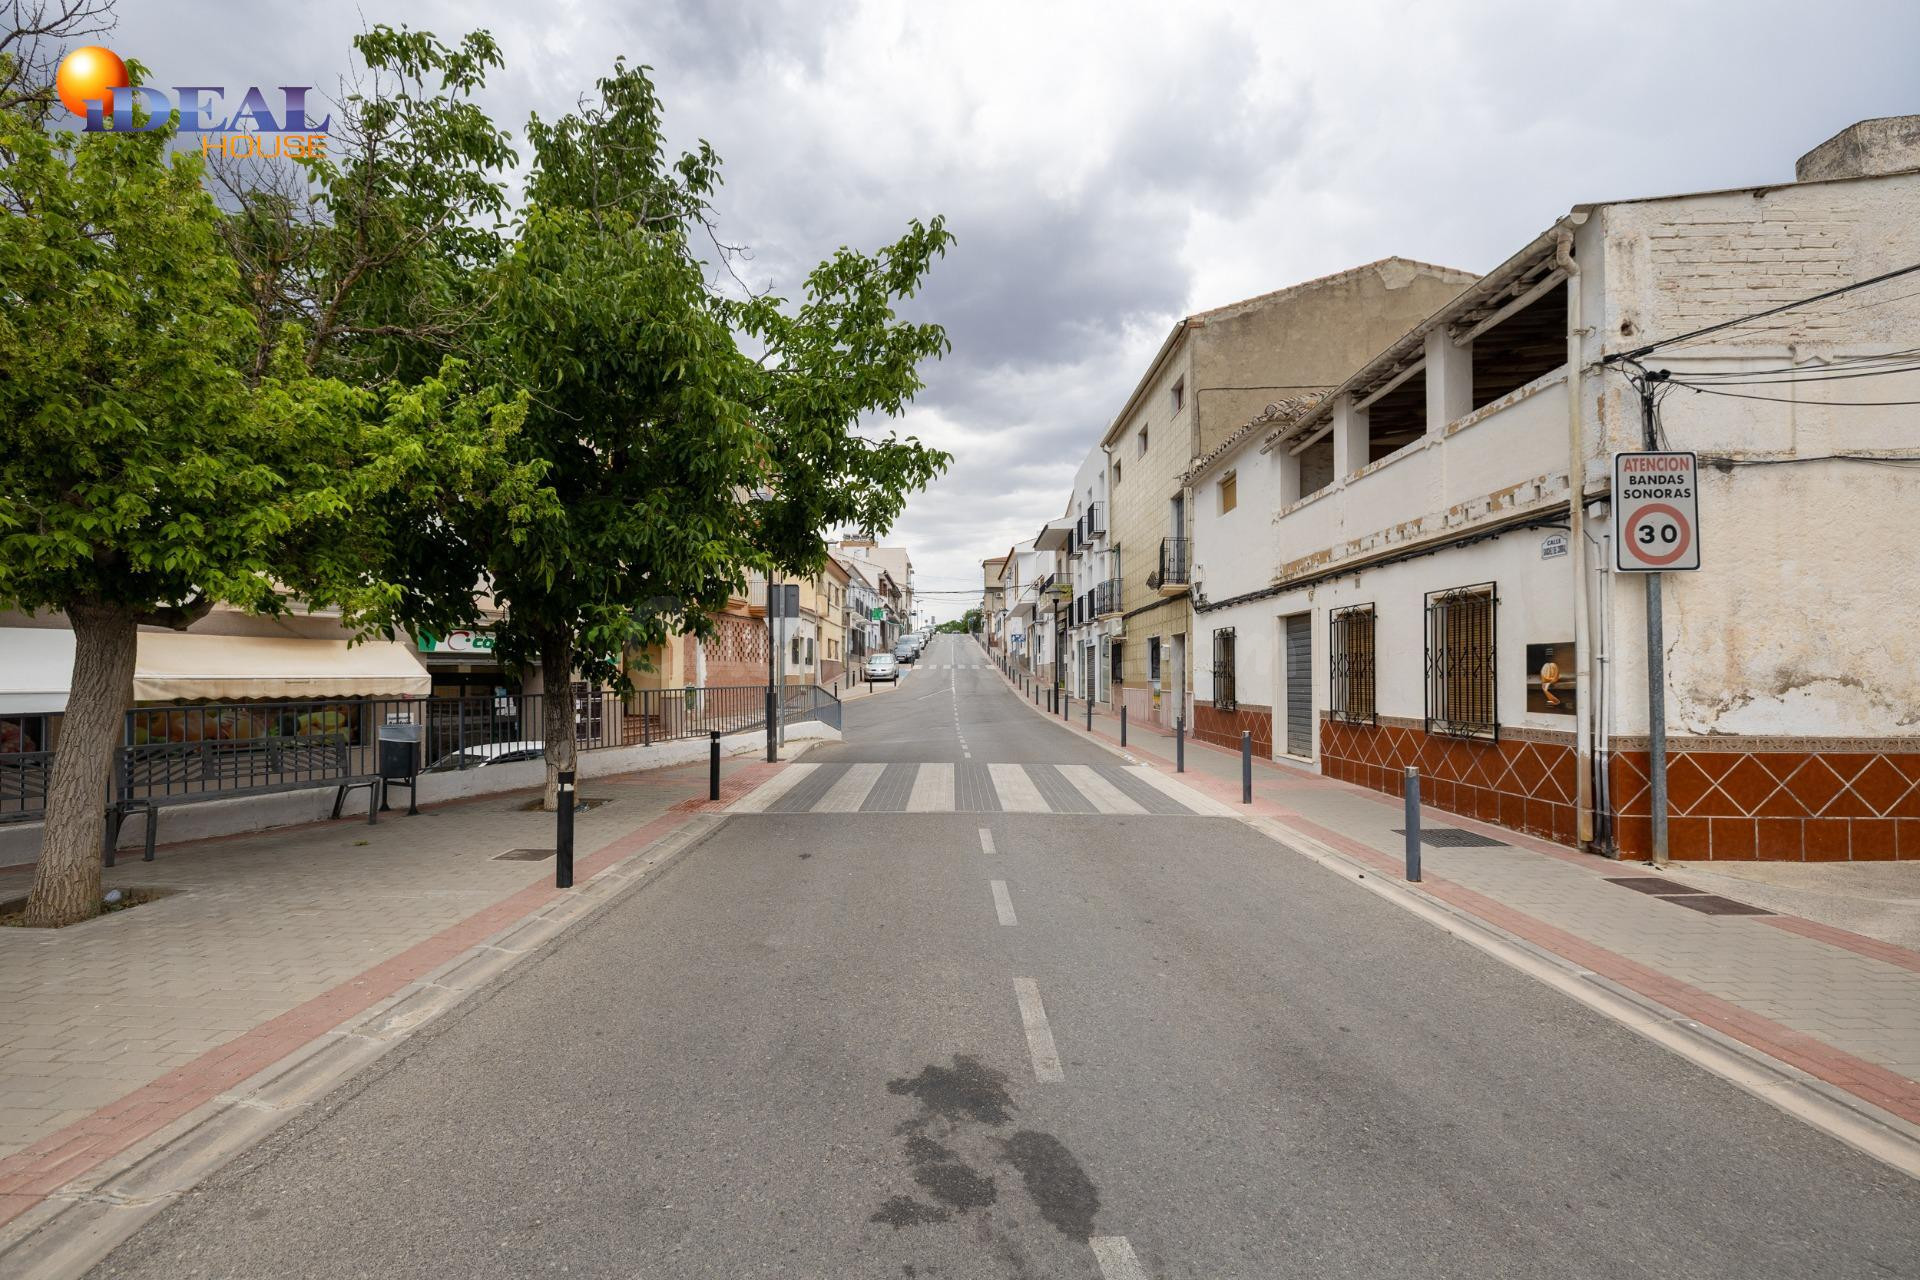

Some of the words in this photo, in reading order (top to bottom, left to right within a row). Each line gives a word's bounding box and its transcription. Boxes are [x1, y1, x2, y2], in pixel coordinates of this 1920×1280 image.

[1623, 457, 1690, 473] ATENCION
[1629, 475, 1685, 485] BANDAS
[1623, 488, 1691, 499] SONORAS
[1638, 524, 1678, 544] 30
